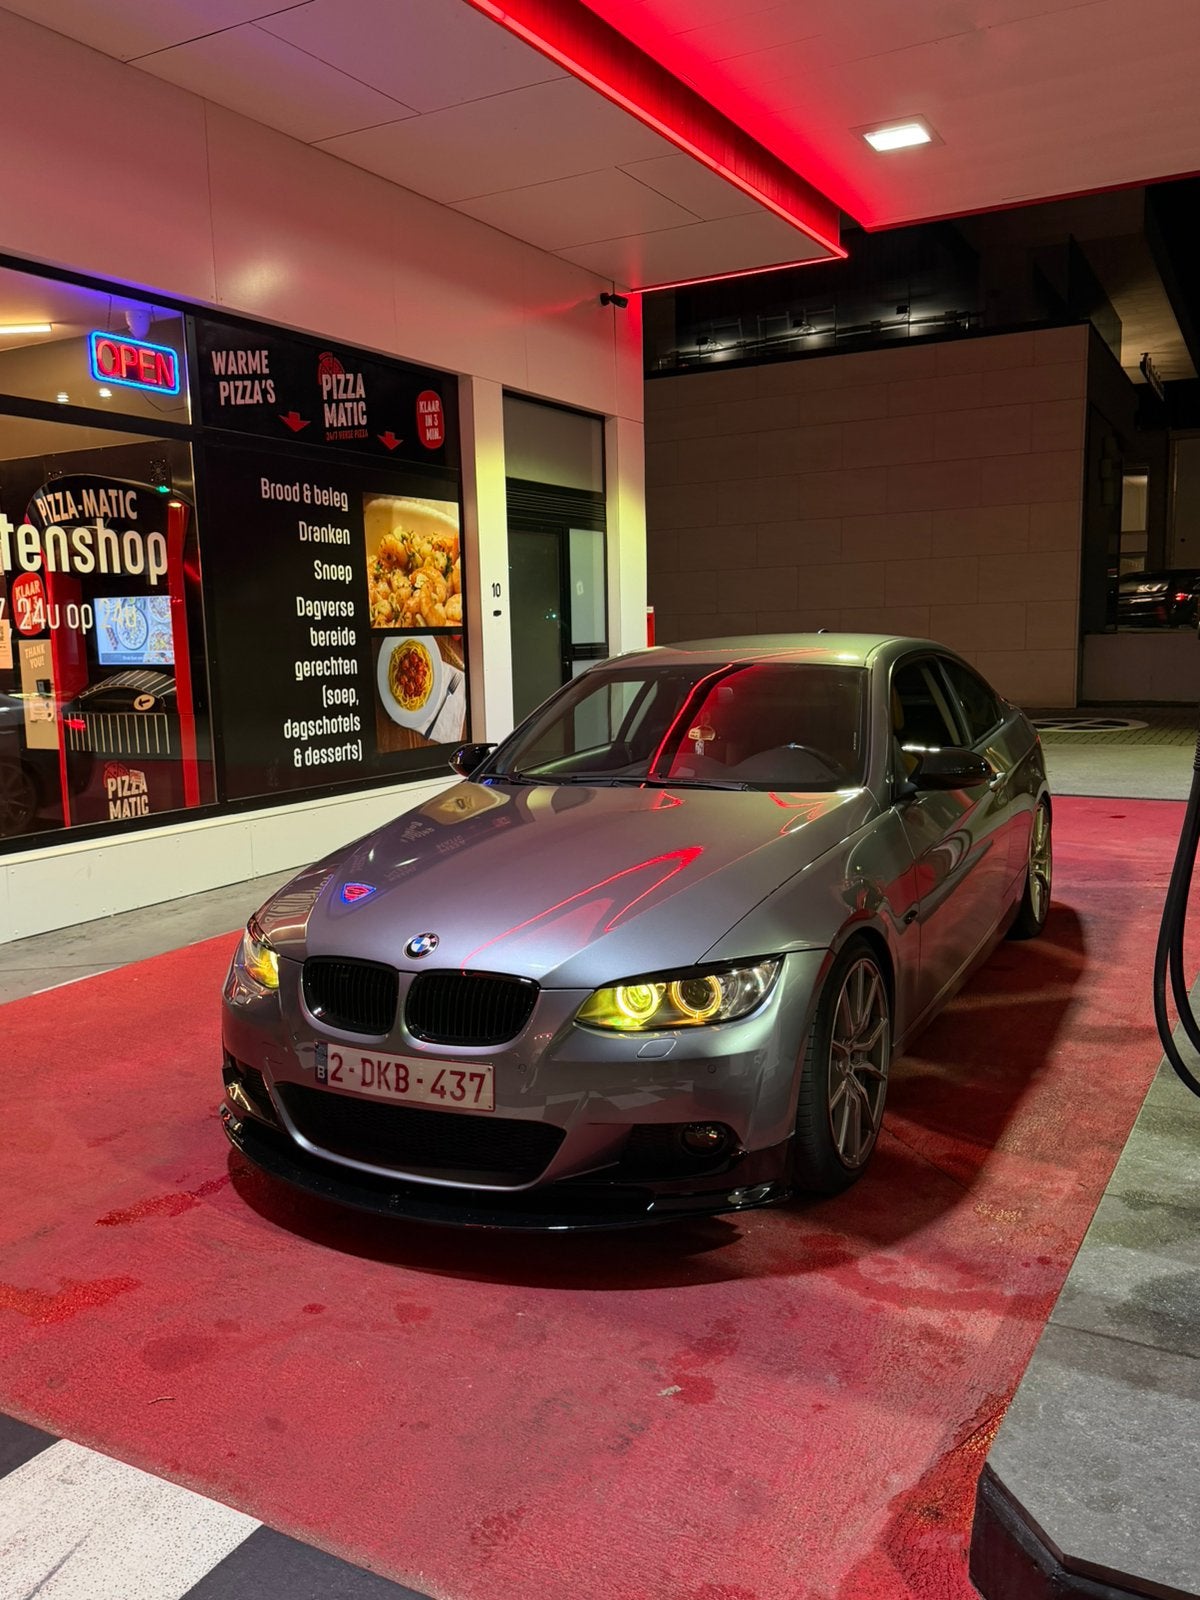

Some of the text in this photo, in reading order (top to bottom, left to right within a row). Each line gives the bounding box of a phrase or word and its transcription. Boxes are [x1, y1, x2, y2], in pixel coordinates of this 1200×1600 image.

[96, 339, 175, 388] OPEN
[212, 350, 270, 375] WARME
[219, 379, 276, 406] PIZZA'S
[322, 373, 366, 400] PIZZA
[324, 401, 367, 428] MATIC
[419, 400, 440, 413] KLAAR
[425, 413, 439, 427] IN 3
[426, 428, 441, 441] MIN.
[36, 488, 138, 526] PIZZA-MATIC
[261, 477, 348, 512] Brood & beleg
[298, 520, 351, 545] Dranken
[313, 559, 353, 584] Snoep
[15, 580, 41, 600] KLAAR
[492, 583, 501, 598] 10
[17, 597, 60, 630] 24u
[66, 603, 94, 635] op
[296, 596, 355, 620] Dagverse
[309, 626, 357, 647] bereide
[24, 643, 46, 660] THANK
[294, 656, 358, 681] gerechten
[322, 684, 360, 708] (soep,
[283, 712, 361, 740] dagschotels
[293, 738, 363, 767] & desserts)
[108, 794, 150, 820] MATIC
[317, 1065, 326, 1079] B
